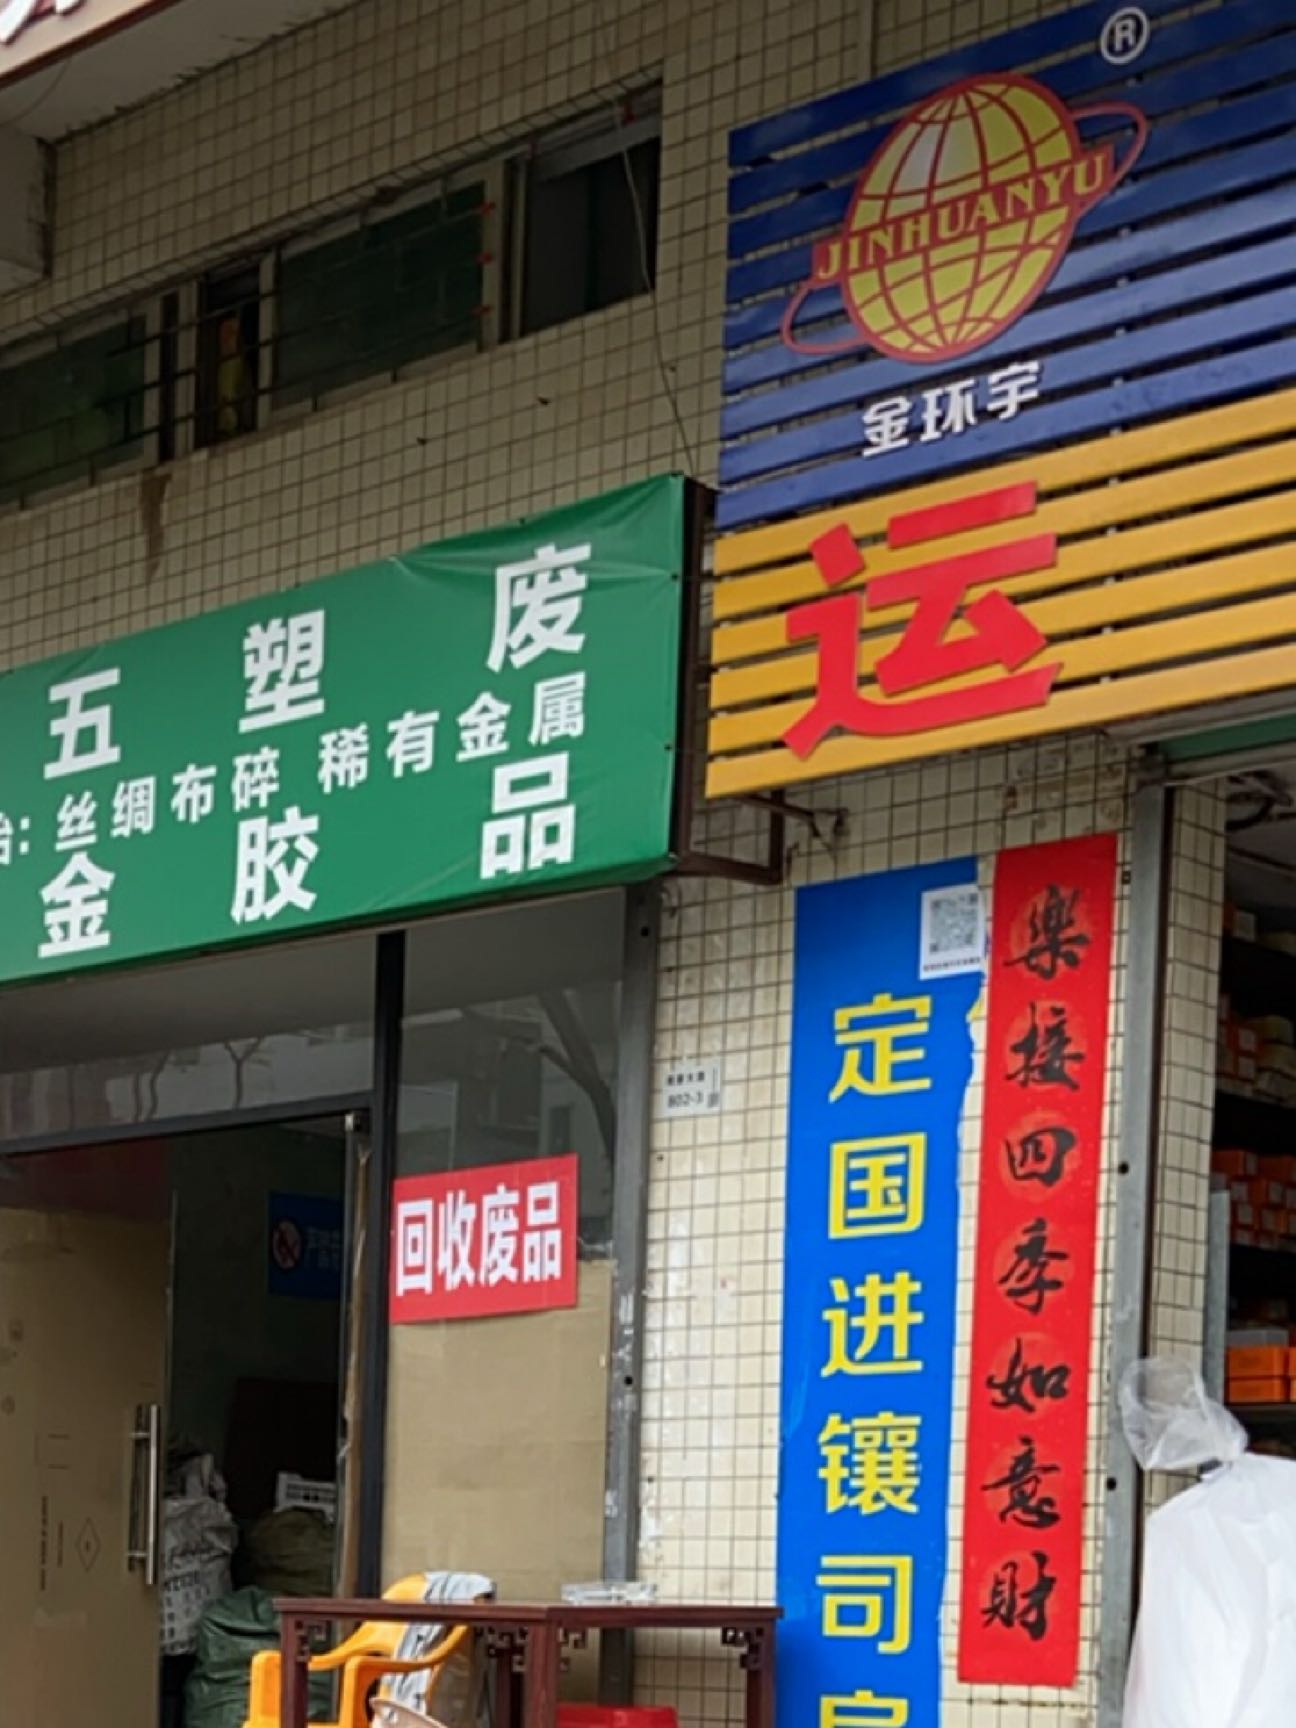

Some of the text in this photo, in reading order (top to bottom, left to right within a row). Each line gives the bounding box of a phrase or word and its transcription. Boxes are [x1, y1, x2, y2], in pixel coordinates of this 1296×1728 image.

[817, 155, 1107, 281] JINHUANYU
[861, 360, 1044, 458] 金环宇
[782, 480, 1063, 760] 运
[395, 1180, 562, 1297] 回收废品
